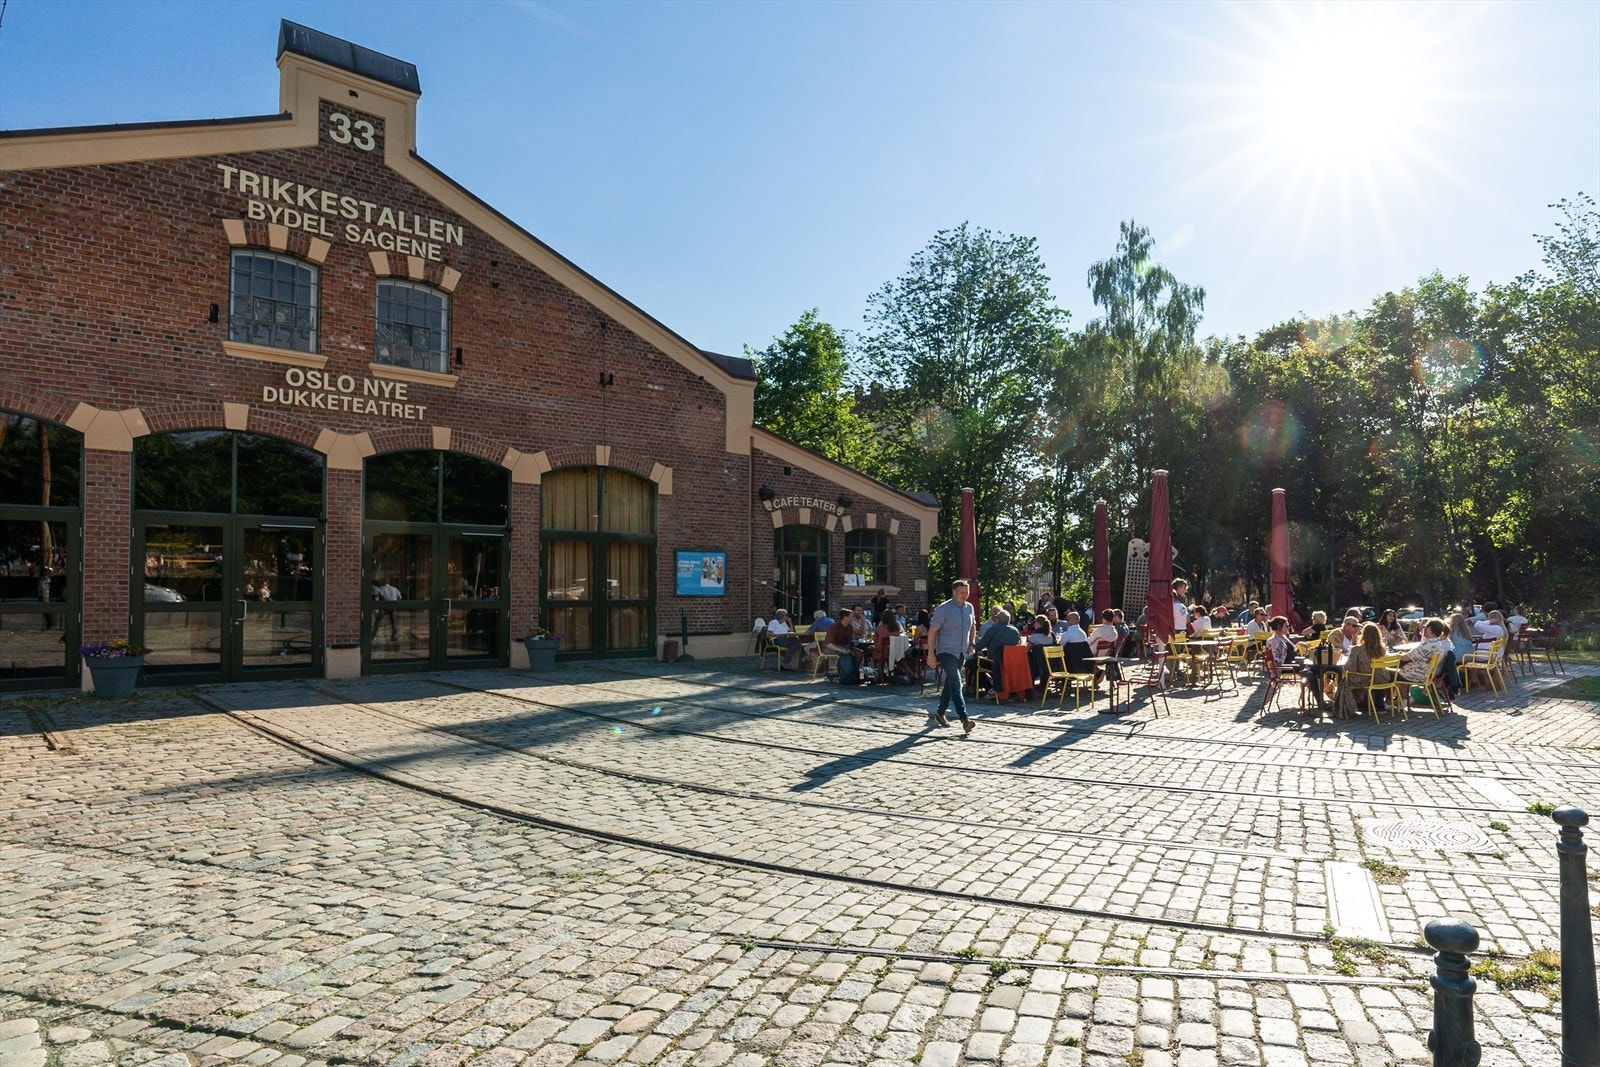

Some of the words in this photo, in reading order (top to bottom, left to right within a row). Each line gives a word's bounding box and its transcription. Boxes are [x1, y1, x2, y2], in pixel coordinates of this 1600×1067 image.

[328, 112, 376, 151] 33
[217, 163, 463, 246] TRIKKESTALLEN
[247, 200, 334, 238] BYDEL
[344, 223, 442, 262] SAGENE
[285, 368, 355, 393] OSLO
[363, 378, 408, 400] NYE
[263, 386, 427, 420] DUKKETEATRET
[800, 496, 836, 513] TEATER
